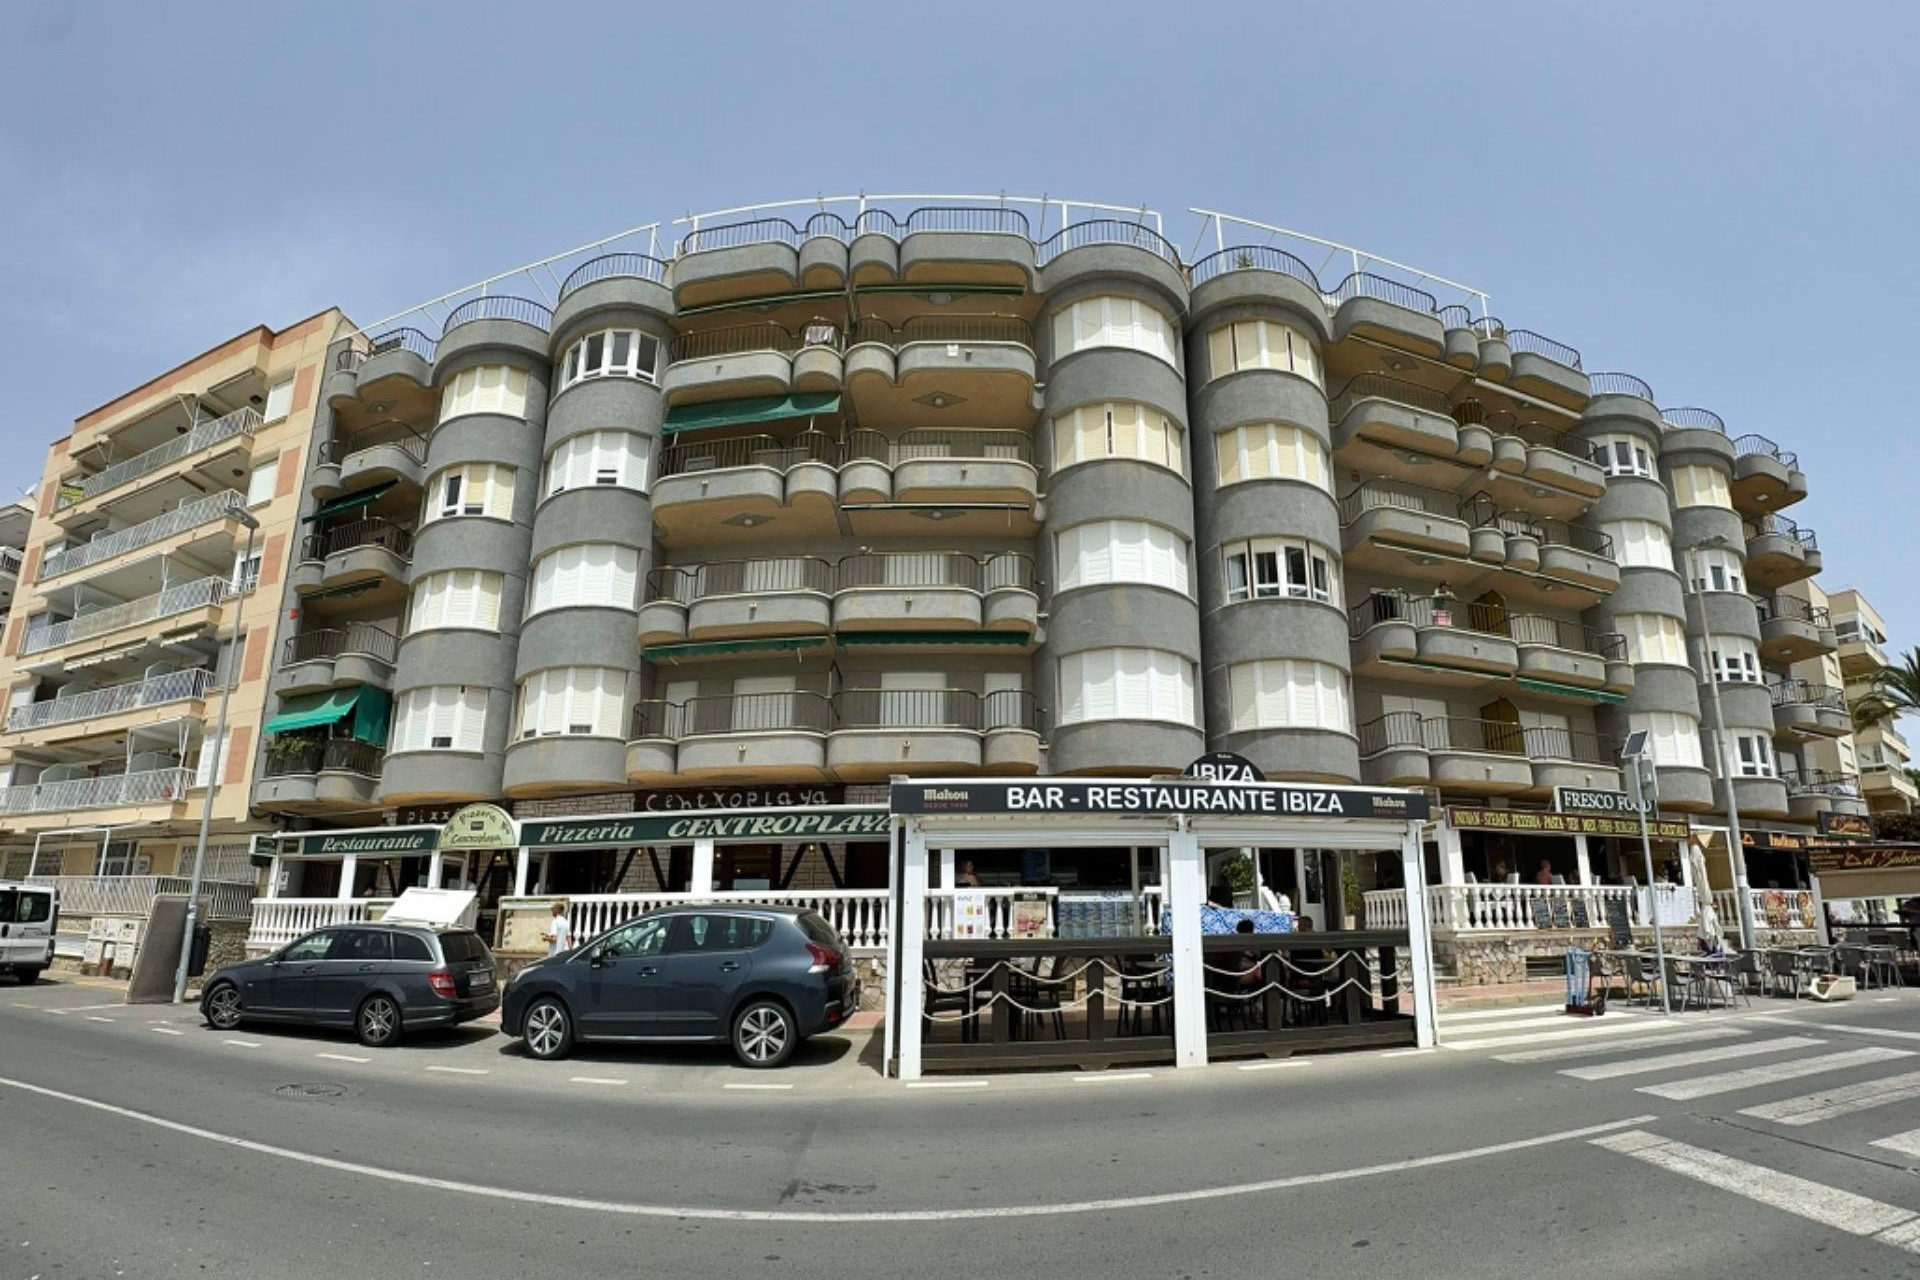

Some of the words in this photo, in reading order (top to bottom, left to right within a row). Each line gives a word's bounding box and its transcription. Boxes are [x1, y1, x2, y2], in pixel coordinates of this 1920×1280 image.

[1192, 763, 1255, 782] IBIZA
[1006, 787, 1064, 809] BAR
[1087, 787, 1277, 812] RESTAURANTE
[1282, 791, 1344, 813] IBIZA
[1563, 791, 1615, 809] FRESCO
[539, 822, 635, 842] Pizzeria
[320, 834, 425, 852] Restaurante
